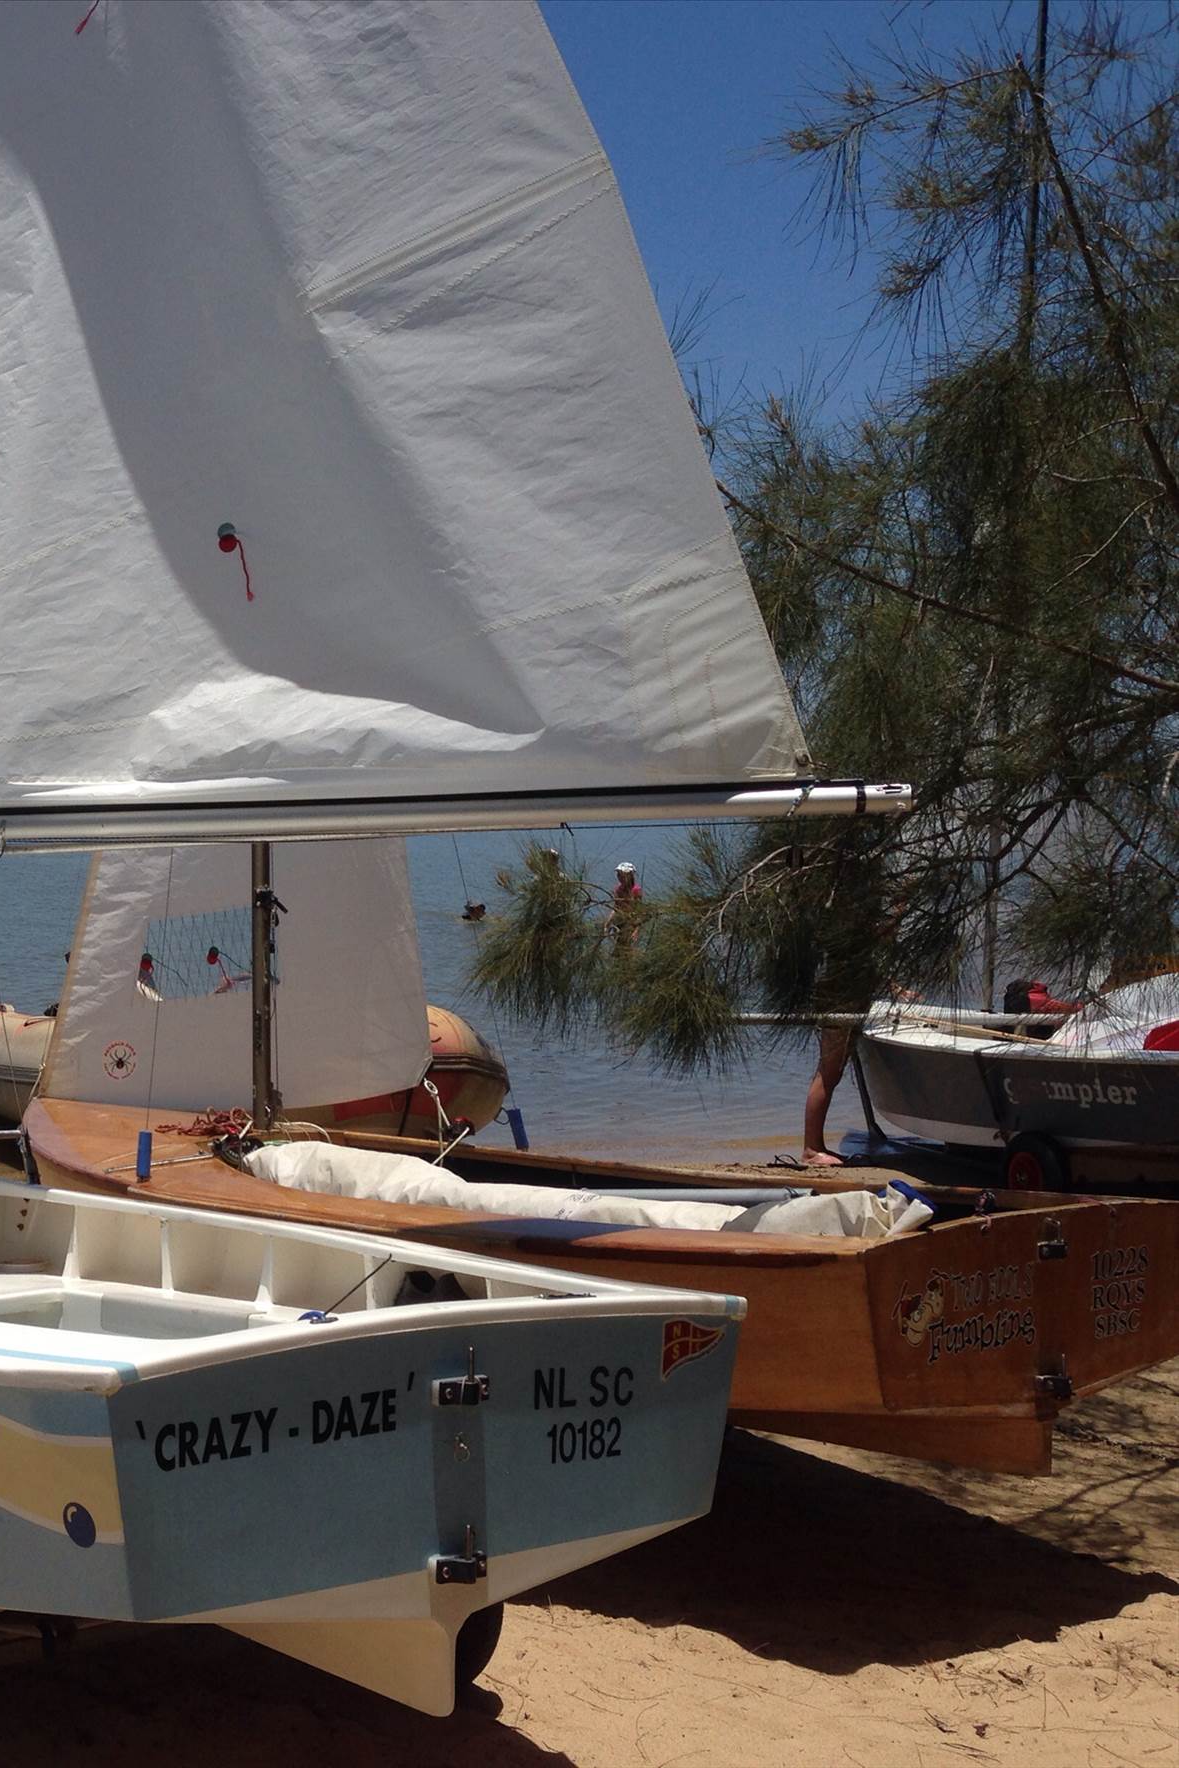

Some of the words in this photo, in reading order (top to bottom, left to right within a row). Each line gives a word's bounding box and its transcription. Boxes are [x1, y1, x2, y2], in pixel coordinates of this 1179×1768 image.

[1090, 1244, 1151, 1280] 10228
[927, 1307, 1036, 1366] Fumbling
[547, 1416, 622, 1464] 10182
